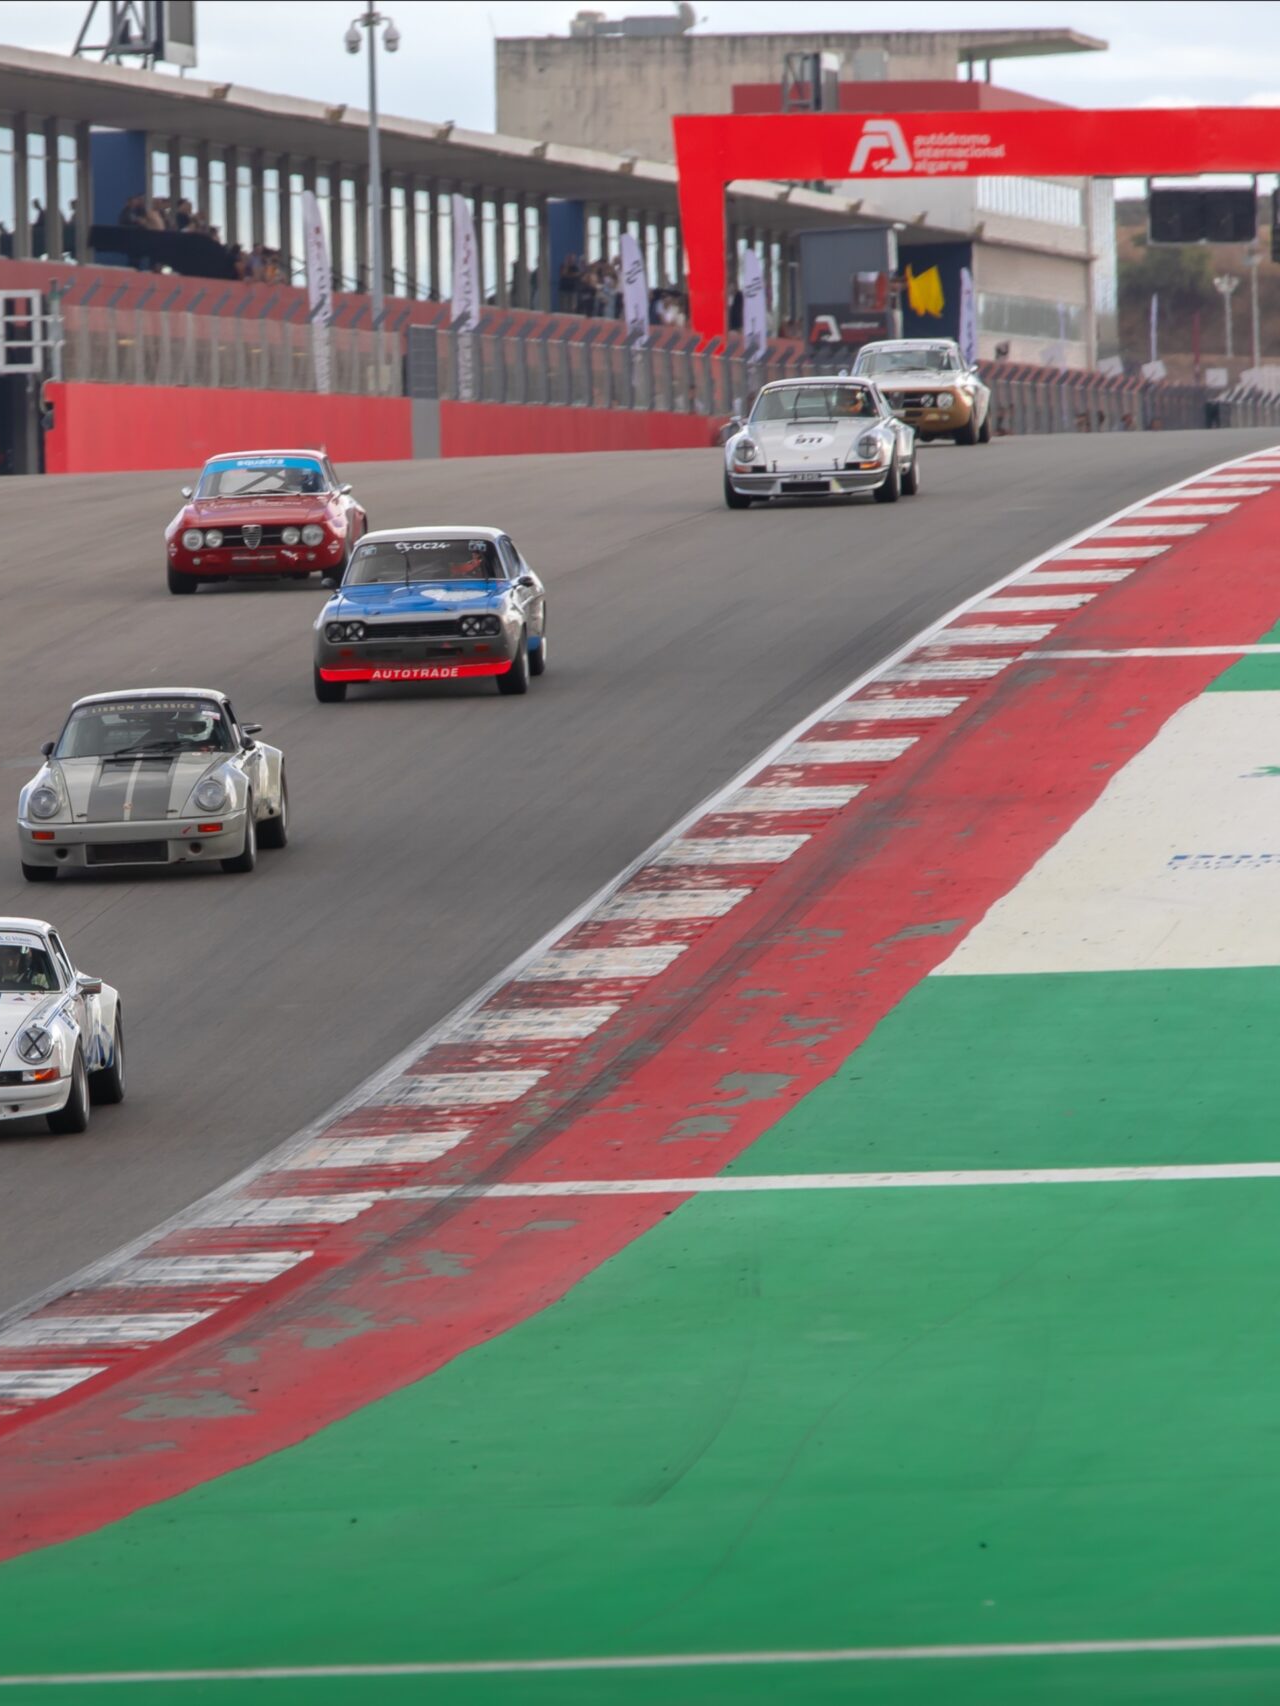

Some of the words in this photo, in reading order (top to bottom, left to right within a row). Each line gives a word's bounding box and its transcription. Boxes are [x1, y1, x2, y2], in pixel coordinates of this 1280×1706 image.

[913, 145, 1005, 158] internacional
[913, 159, 969, 174] algarve
[372, 667, 459, 679] AUTOTRADE
[91, 704, 135, 714] LISBON
[140, 703, 196, 711] CLASSICS
